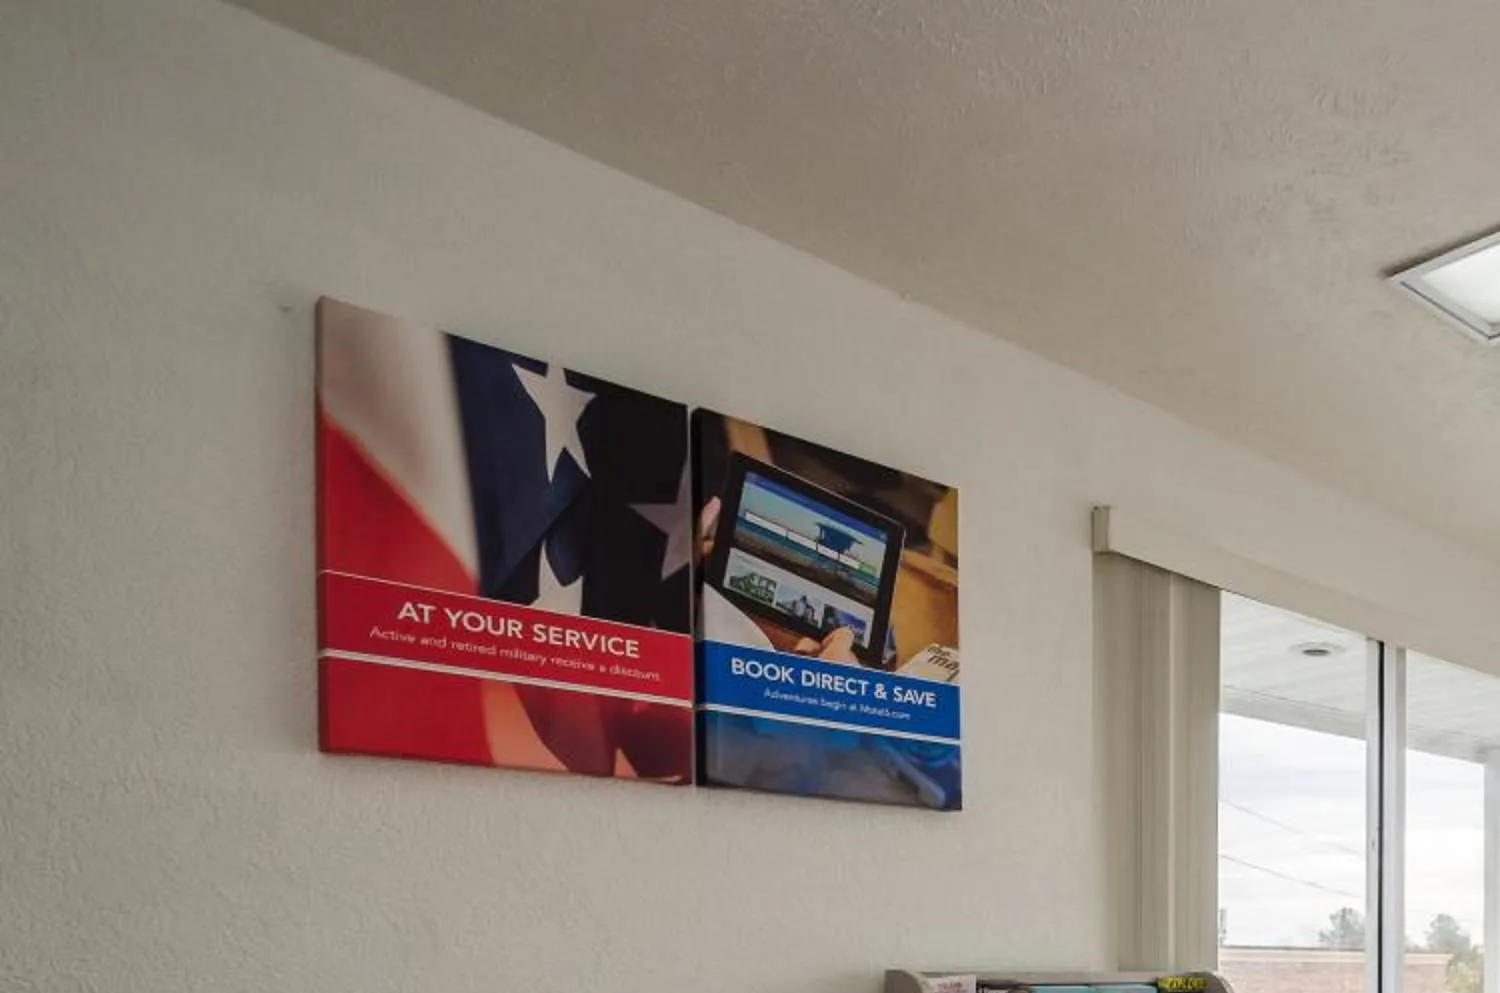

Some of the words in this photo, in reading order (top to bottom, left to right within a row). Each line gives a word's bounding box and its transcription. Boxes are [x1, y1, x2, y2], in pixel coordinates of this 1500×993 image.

[369, 625, 416, 644] Active
[420, 636, 447, 649] and
[451, 640, 497, 656] retired
[500, 645, 546, 667] military
[550, 656, 595, 672] receive
[599, 664, 607, 673] a
[397, 601, 437, 625] AT
[443, 607, 524, 639] YOUR
[532, 623, 641, 659] SERVICE
[731, 657, 795, 684] BOOK
[801, 669, 869, 697] DIRECT
[873, 682, 888, 700] &
[893, 686, 937, 708] SAVE
[763, 687, 819, 705] Adventures
[820, 697, 847, 711] begin
[849, 701, 858, 711] at
